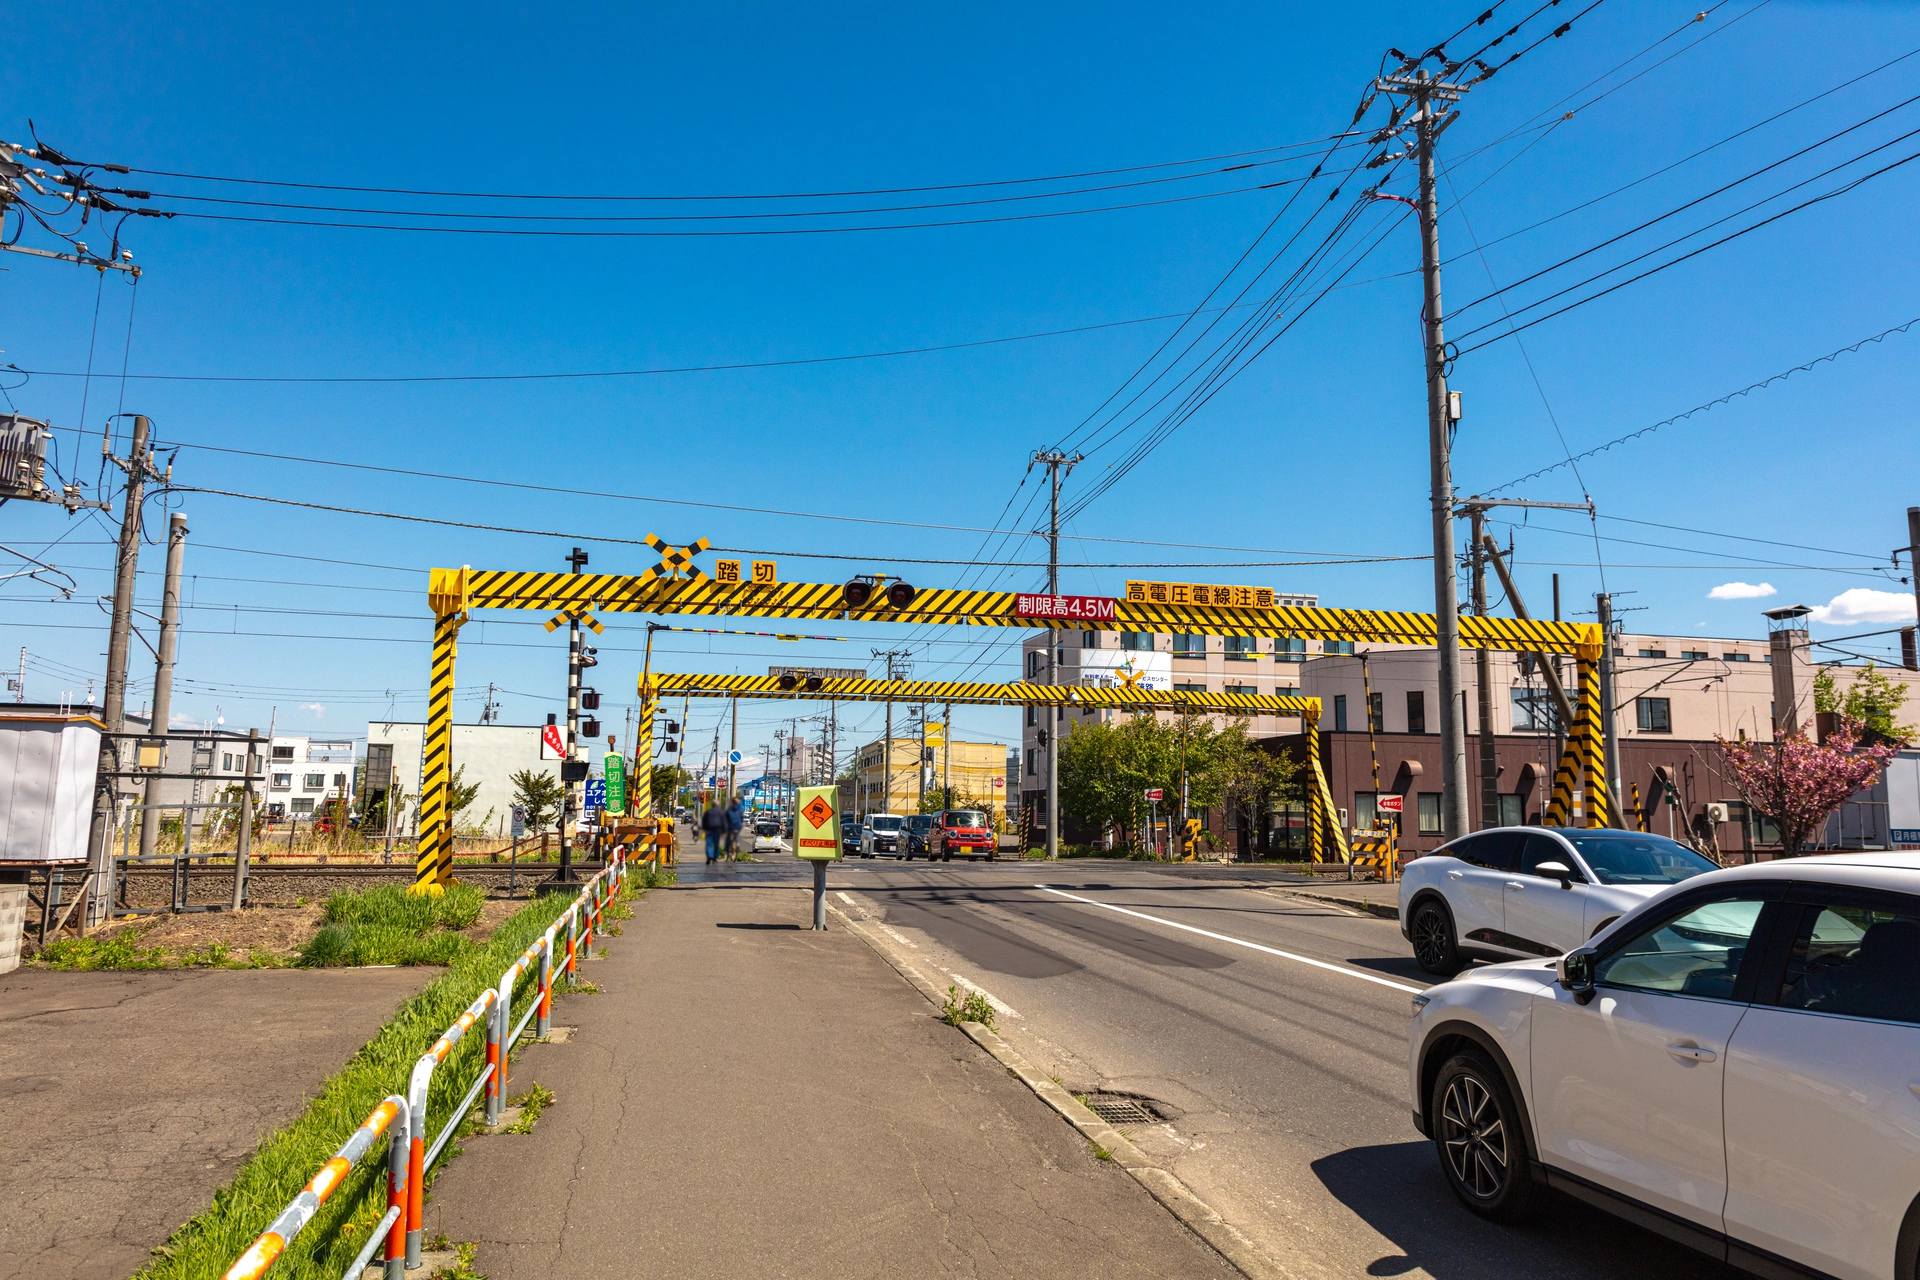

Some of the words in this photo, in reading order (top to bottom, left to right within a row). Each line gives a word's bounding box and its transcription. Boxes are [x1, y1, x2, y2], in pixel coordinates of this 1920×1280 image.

[718, 562, 774, 582] 踏切
[1018, 596, 1115, 619] 制限高4.5M
[1127, 583, 1273, 608] 高電圧電線注意
[607, 757, 621, 812] 踏切注意
